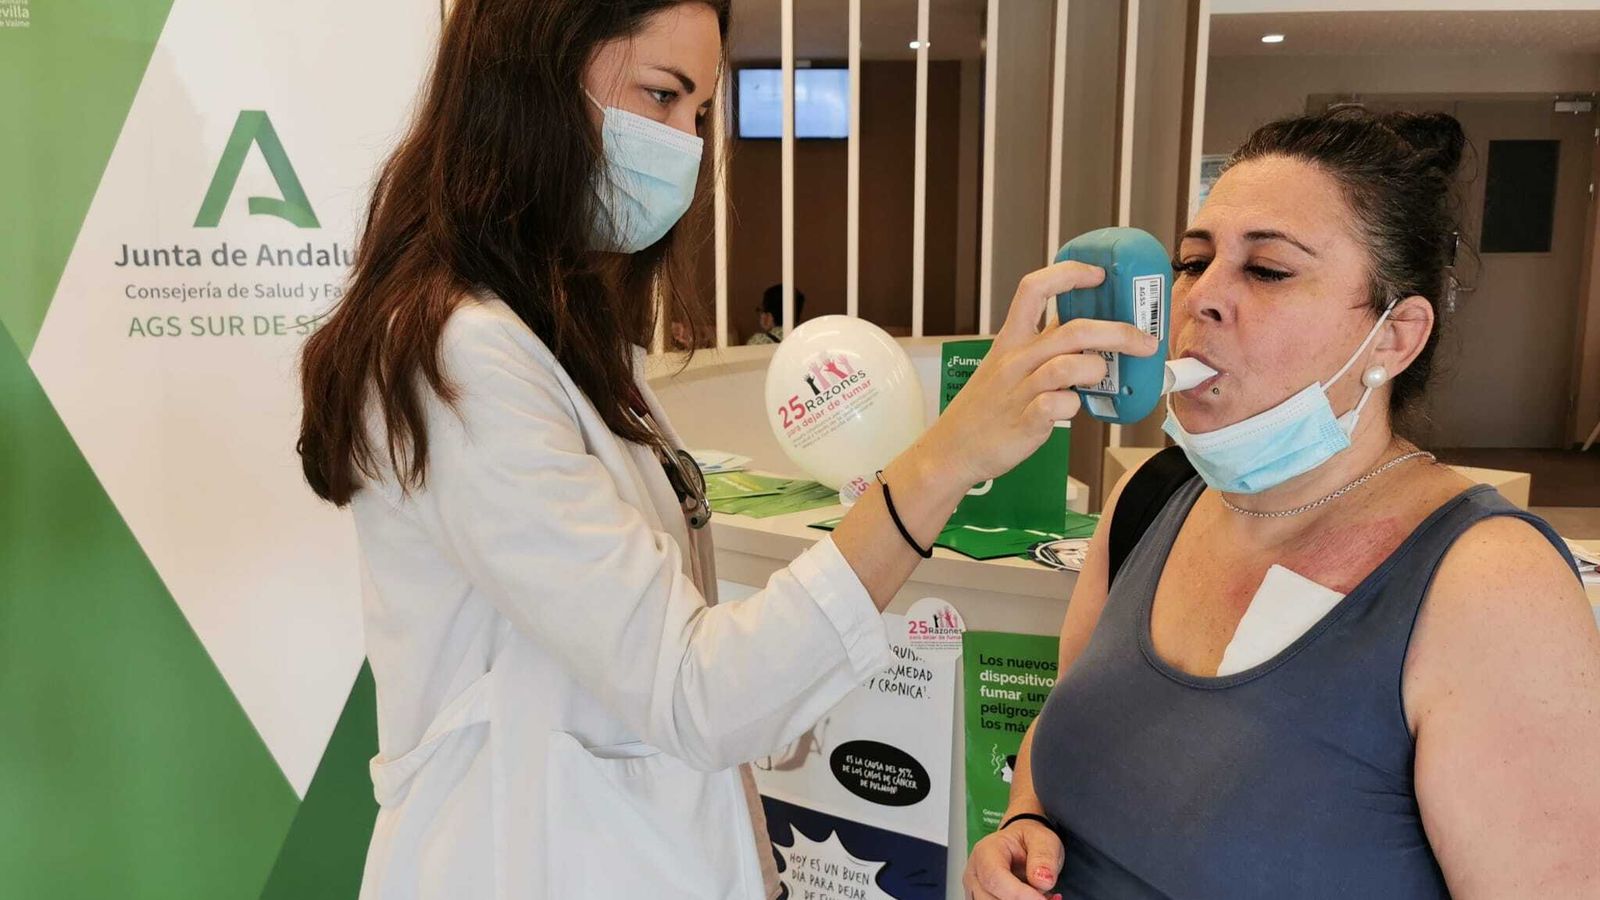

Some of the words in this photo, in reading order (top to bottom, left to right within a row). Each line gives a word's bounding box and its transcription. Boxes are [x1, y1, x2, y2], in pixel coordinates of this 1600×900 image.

[114, 243, 201, 268] Junta
[211, 242, 247, 267] de
[125, 282, 222, 302] Consejería
[227, 283, 249, 298] de
[254, 283, 304, 298] Salud
[310, 287, 319, 301] y
[128, 315, 182, 337] AGS
[191, 315, 245, 337] SUR
[254, 315, 287, 335] DE
[778, 395, 806, 429] 25
[804, 368, 866, 412] Razones
[801, 410, 825, 428] dejar
[827, 400, 841, 411] de
[842, 379, 872, 401] fumar
[852, 477, 870, 491] 25
[908, 620, 928, 634] 25
[980, 654, 1004, 667] Los
[1007, 658, 1057, 671] nuevos
[980, 670, 1056, 687] dispositivo
[980, 685, 1024, 702] fumar,
[981, 717, 1001, 730] los
[842, 764, 850, 773] DE
[851, 766, 863, 777] LOS
[863, 769, 882, 781] CASOS
[882, 774, 892, 786] DE
[846, 755, 854, 764] ES
[855, 757, 863, 766] LA
[864, 759, 884, 771] CAUSA
[885, 764, 897, 774] DEL
[898, 767, 914, 779] 95%
[860, 779, 869, 788] DE
[790, 853, 807, 867] HOY
[810, 859, 821, 872] ES
[824, 863, 838, 876] UN
[842, 866, 870, 885] BUEN
[792, 866, 806, 882] DÍA
[810, 873, 834, 891] PARA
[838, 883, 866, 900] DEJAR
